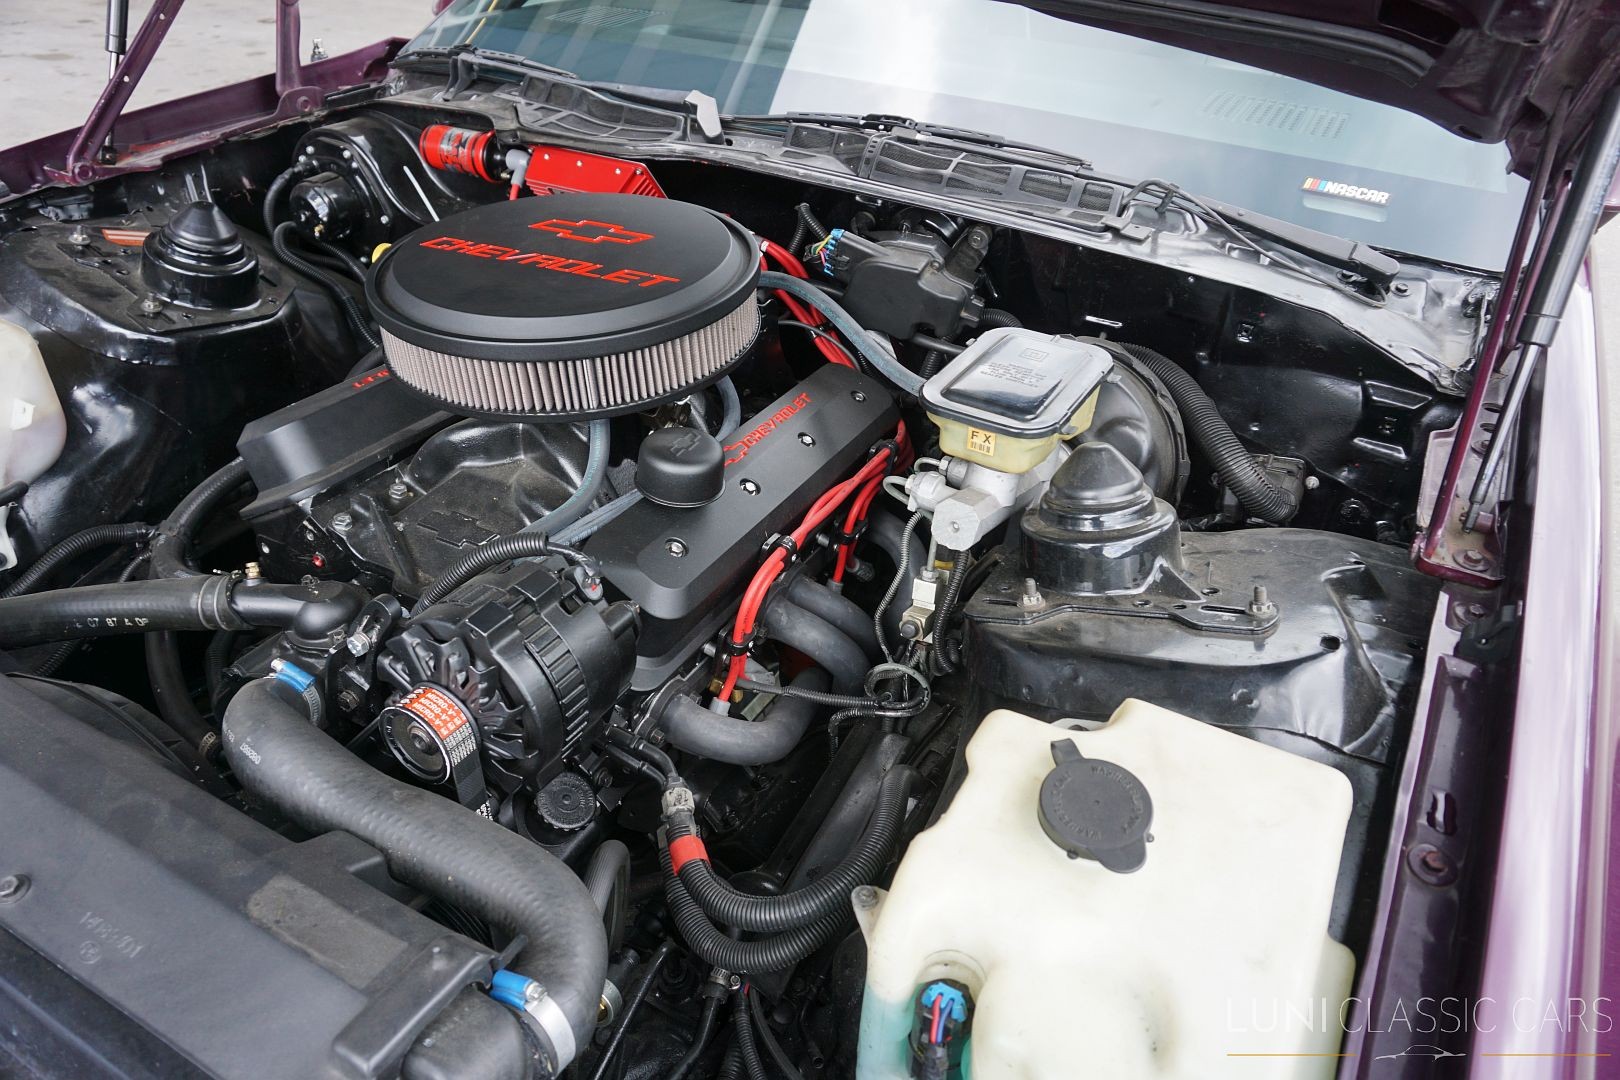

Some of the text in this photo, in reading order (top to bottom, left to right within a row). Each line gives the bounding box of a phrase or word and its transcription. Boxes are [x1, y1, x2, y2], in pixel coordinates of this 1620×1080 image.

[1324, 181, 1389, 204] NASCAR
[420, 236, 681, 288] CHEVROLET
[743, 392, 813, 450] CHEVROLET
